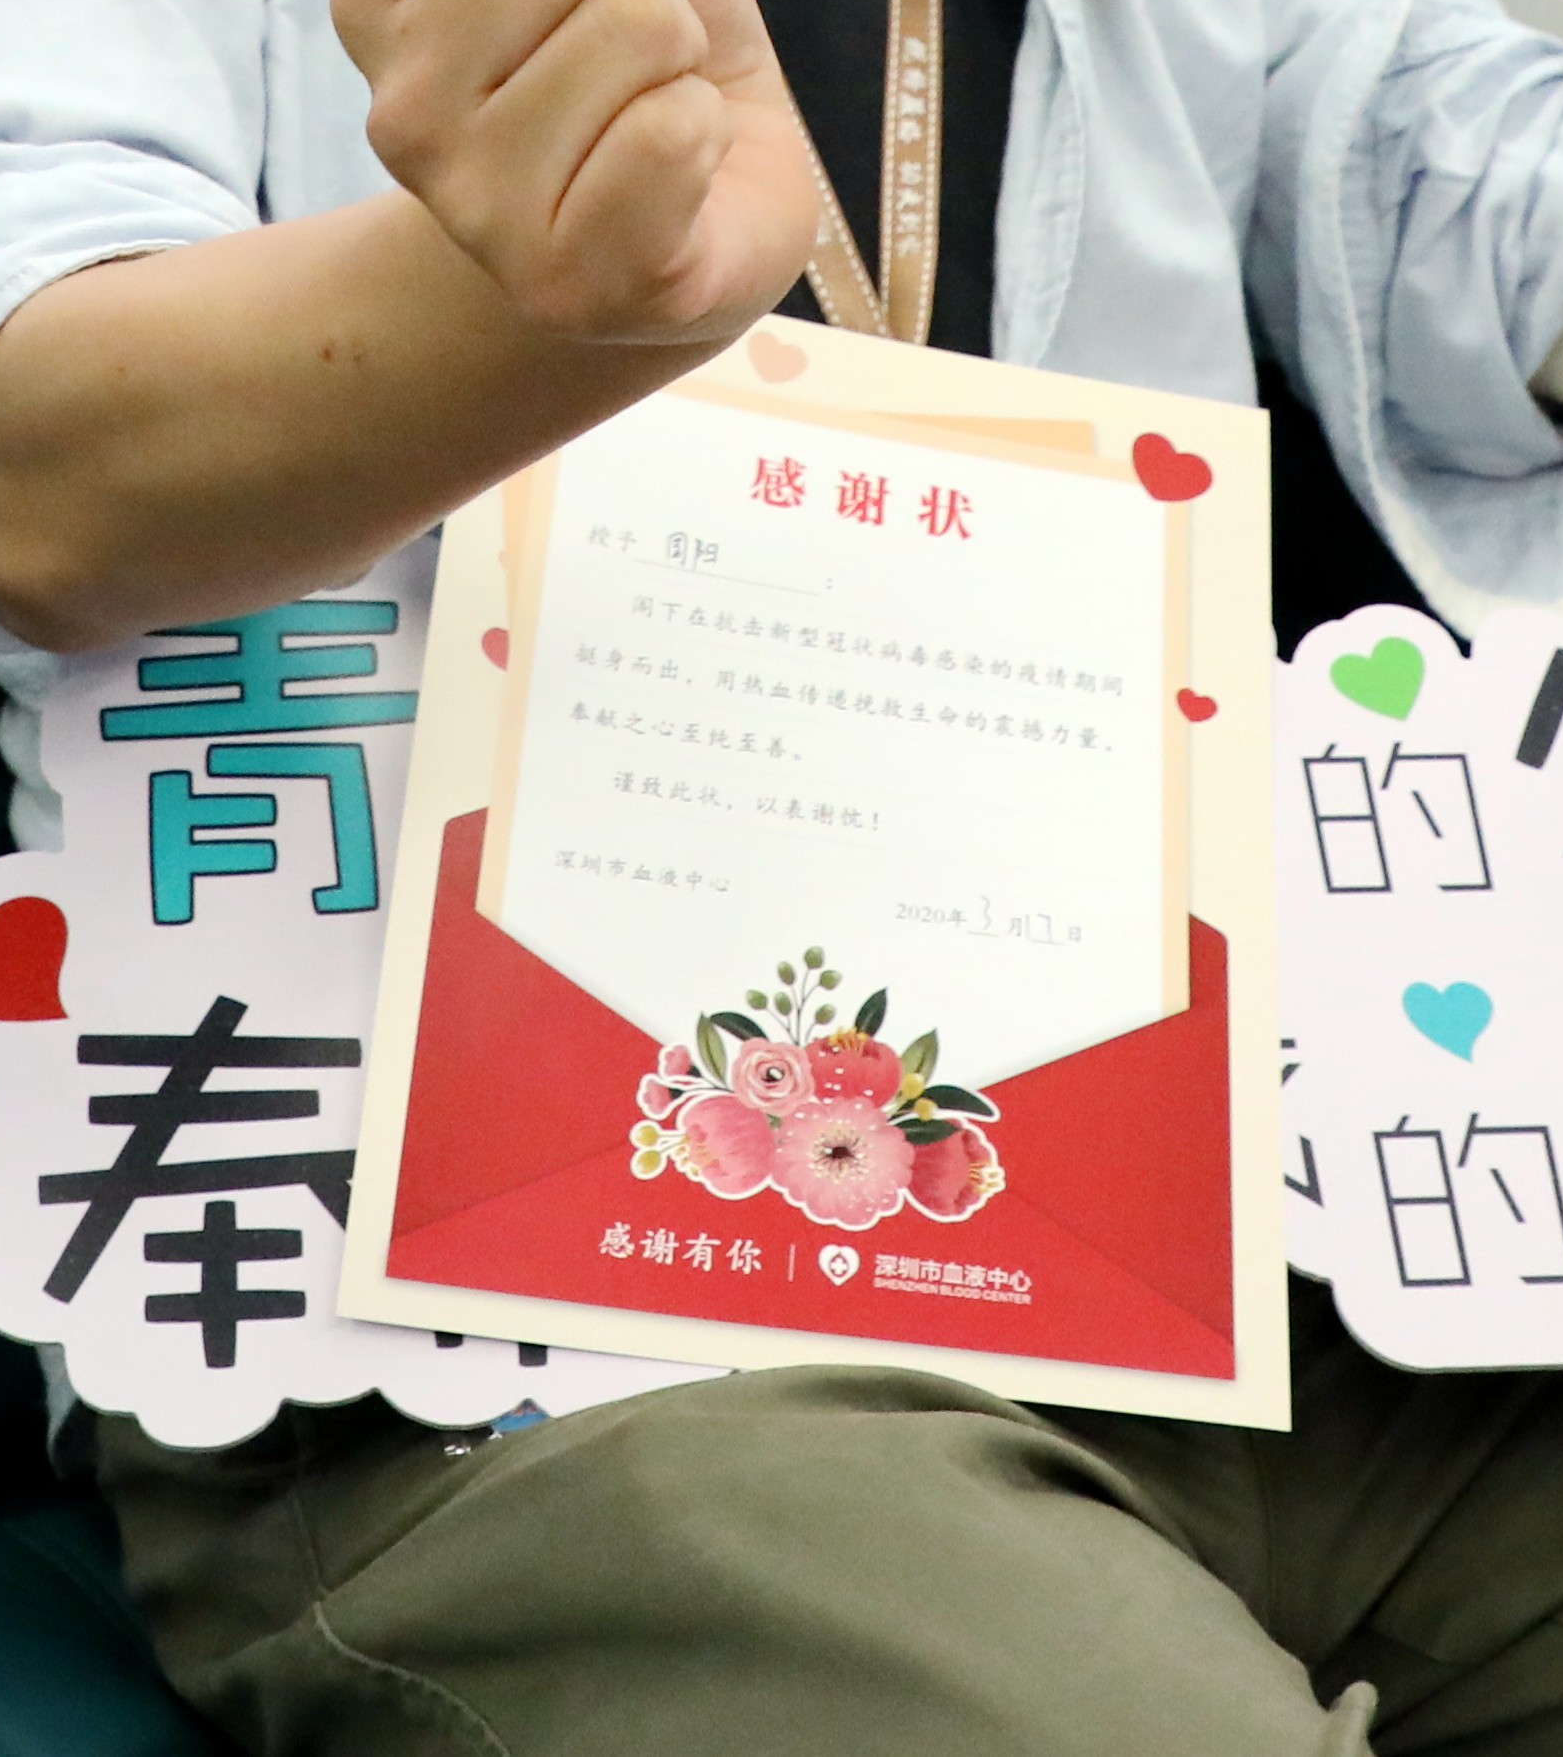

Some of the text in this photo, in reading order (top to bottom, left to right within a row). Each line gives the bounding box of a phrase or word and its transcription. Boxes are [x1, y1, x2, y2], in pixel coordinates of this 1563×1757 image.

[749, 456, 975, 541] 感谢状
[588, 525, 637, 552] 授予
[631, 594, 1124, 697] 阁下在抗击新型冠状病毒感染的疫情期间
[554, 849, 731, 893] 深圳市血液中心
[598, 1220, 764, 1277] 感谢有你
[874, 1253, 1033, 1293] 深圳市血液中心
